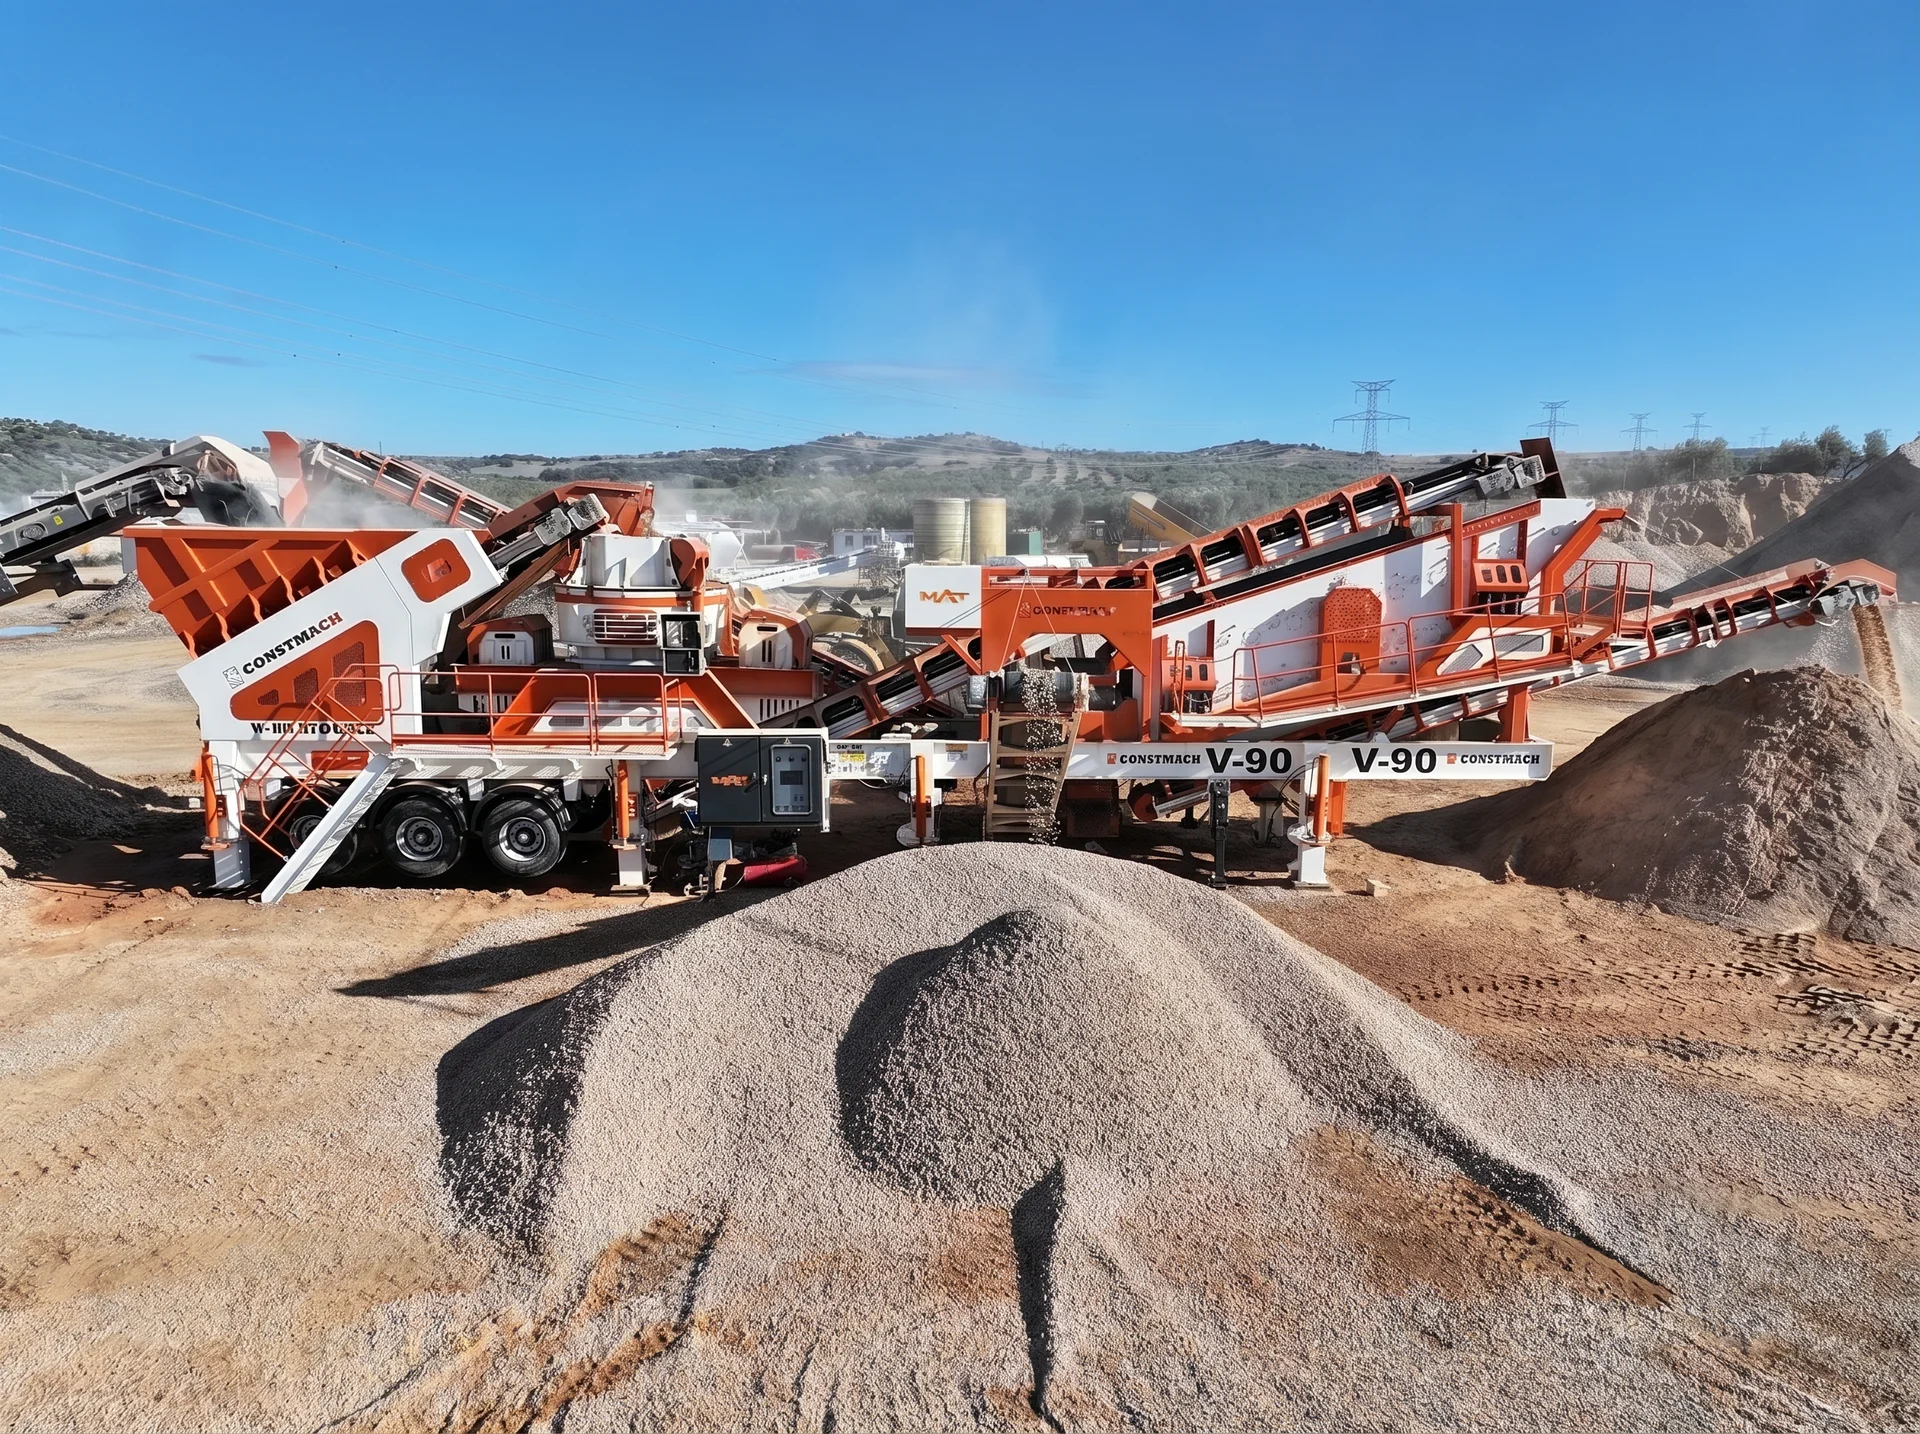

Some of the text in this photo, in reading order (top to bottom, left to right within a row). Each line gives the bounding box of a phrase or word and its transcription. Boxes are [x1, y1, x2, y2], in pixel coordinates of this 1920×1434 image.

[919, 589, 970, 604] MAT
[242, 611, 343, 675] CONSTMACH
[1119, 747, 1292, 774] CONSTMACH V-90
[1351, 747, 1540, 774] V-90 CONSTMACH
